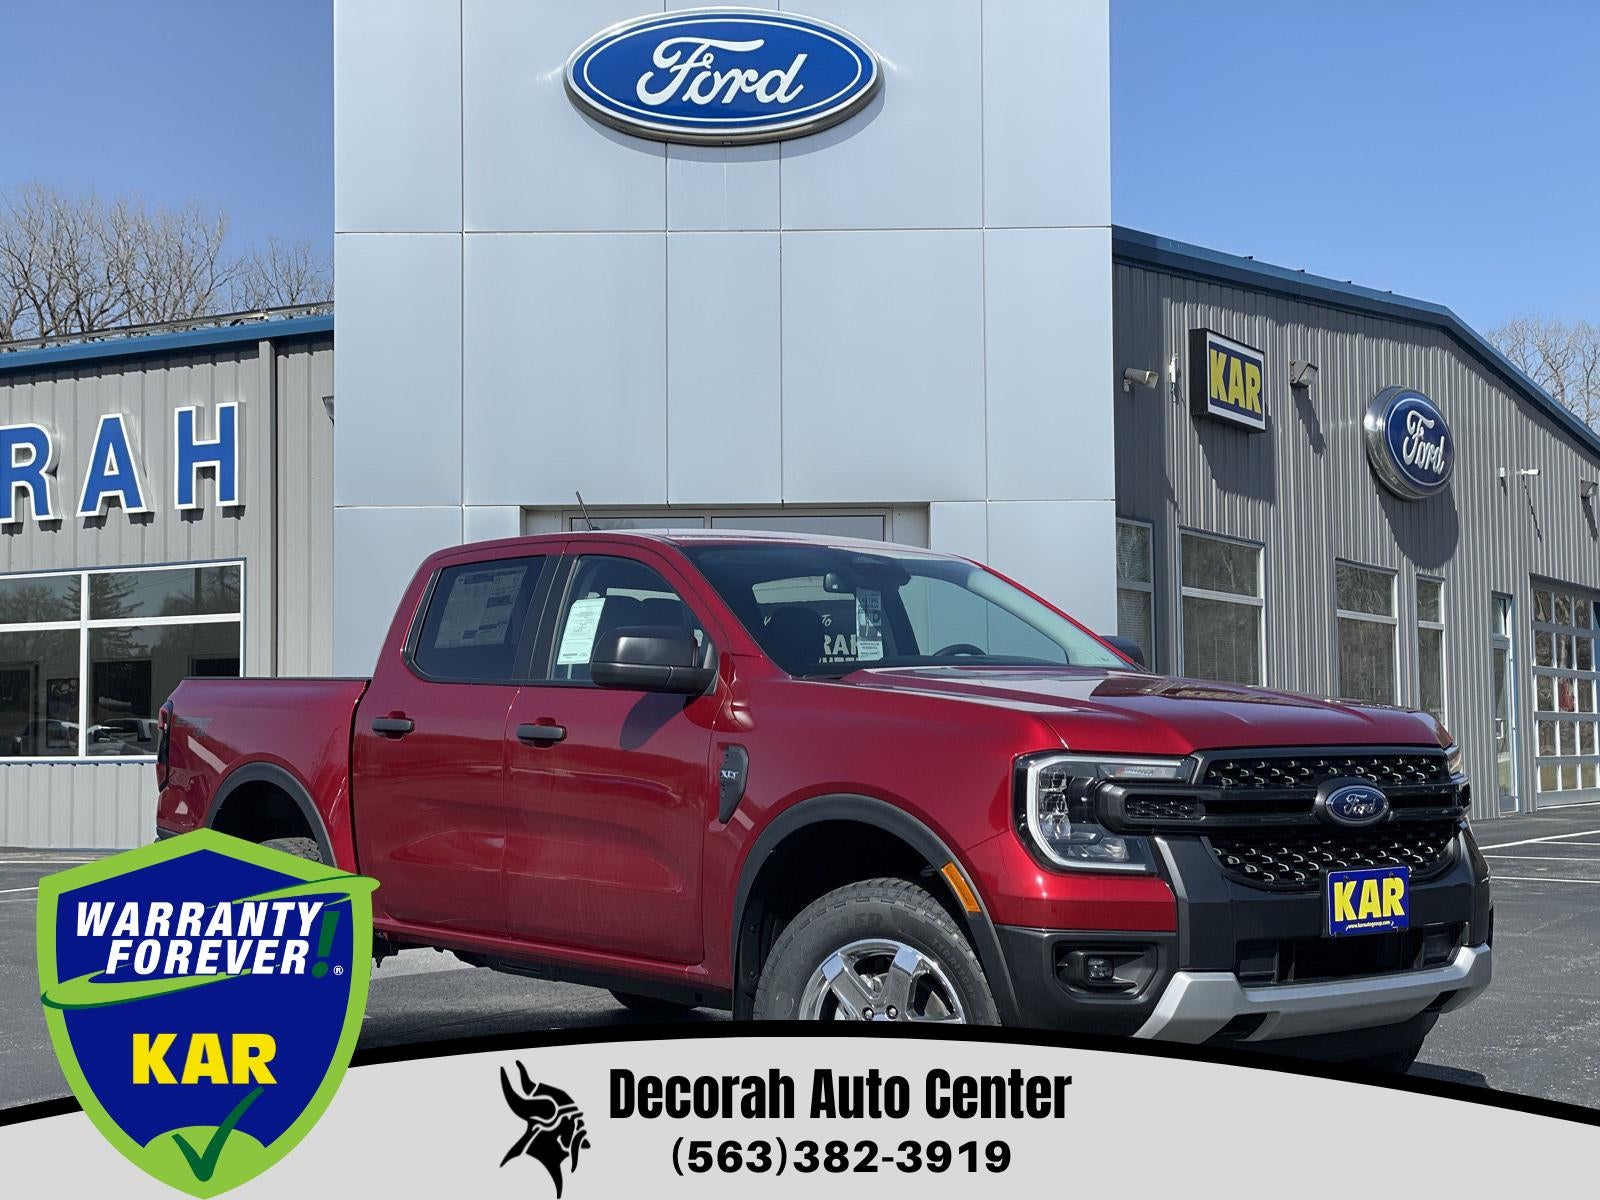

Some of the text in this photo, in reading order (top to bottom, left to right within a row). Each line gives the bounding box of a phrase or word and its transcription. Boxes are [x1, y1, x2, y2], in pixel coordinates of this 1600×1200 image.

[636, 37, 808, 106] Ford
[1210, 350, 1262, 413] KAR
[0, 401, 239, 523] RAH
[1402, 410, 1445, 475] Ford
[721, 769, 739, 780] XLT
[1343, 793, 1377, 815] Ford
[1333, 876, 1405, 923] KAR
